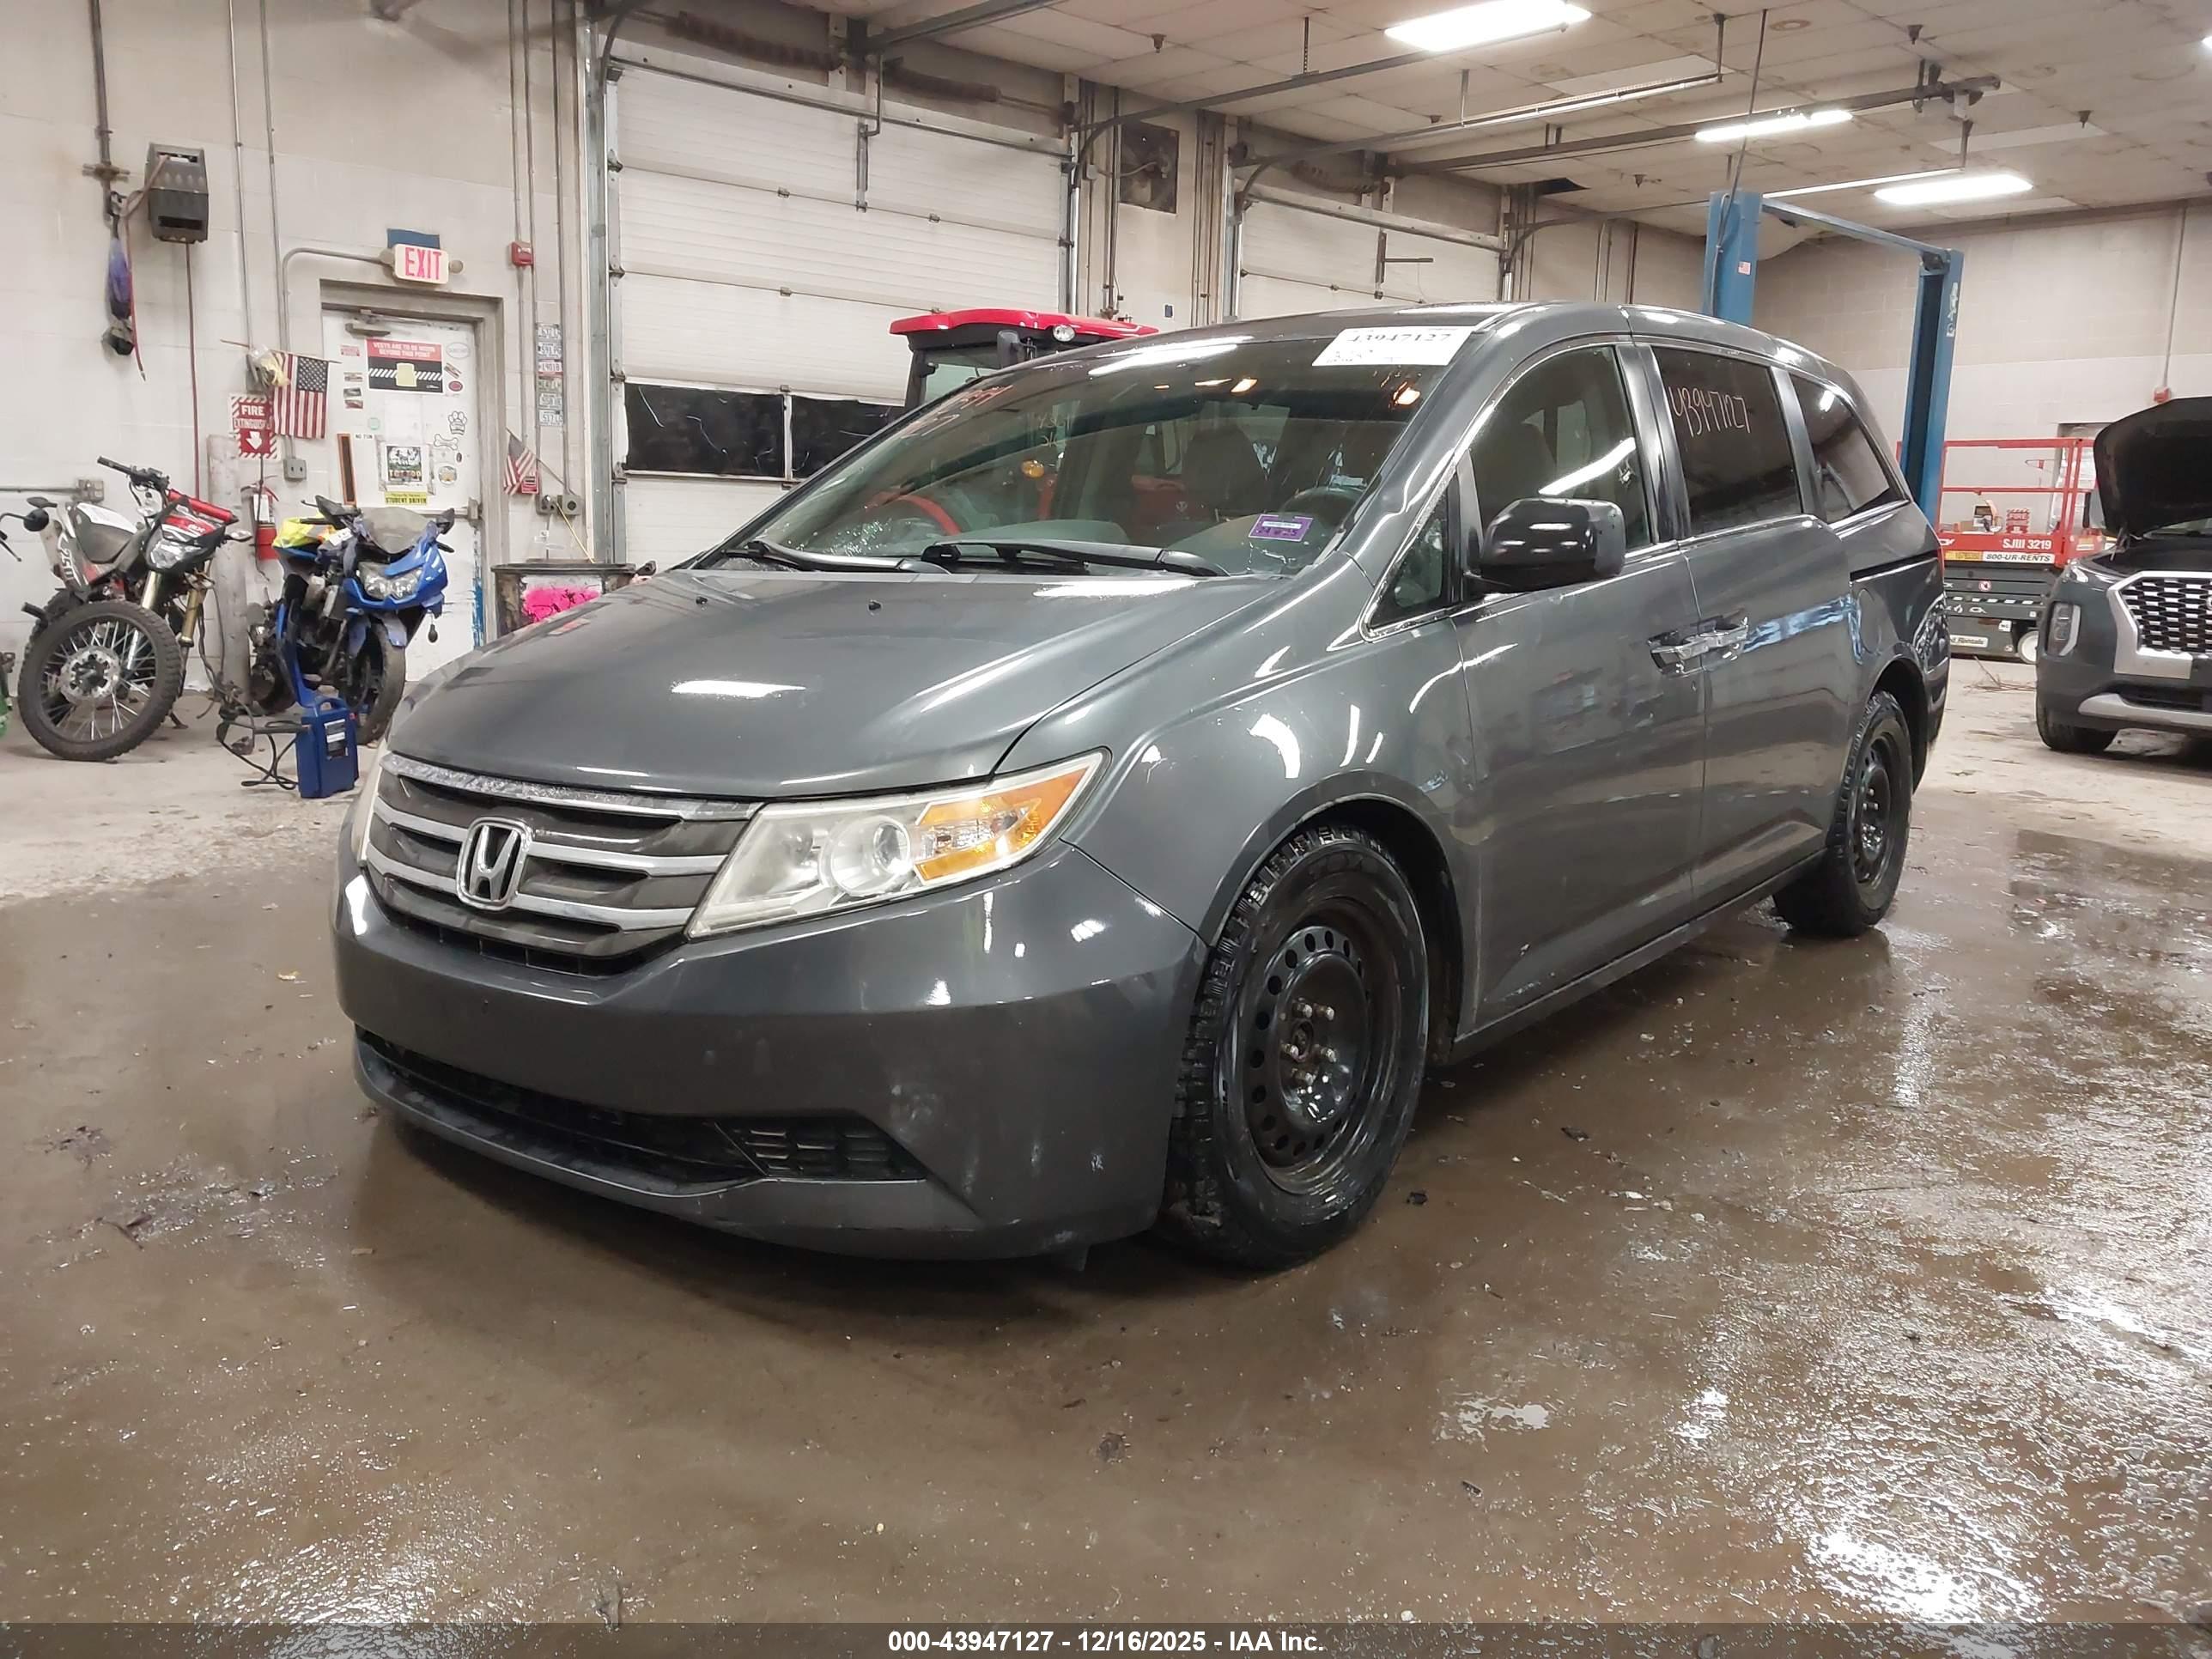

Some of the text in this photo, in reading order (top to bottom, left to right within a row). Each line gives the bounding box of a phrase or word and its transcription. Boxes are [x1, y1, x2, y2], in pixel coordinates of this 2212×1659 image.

[405, 246, 441, 281] EXIT
[241, 404, 265, 416] FIRE
[1668, 386, 1751, 437] 43947127
[2027, 539, 2052, 550] 3219
[1986, 553, 2051, 562] 800-UR-RENTS
